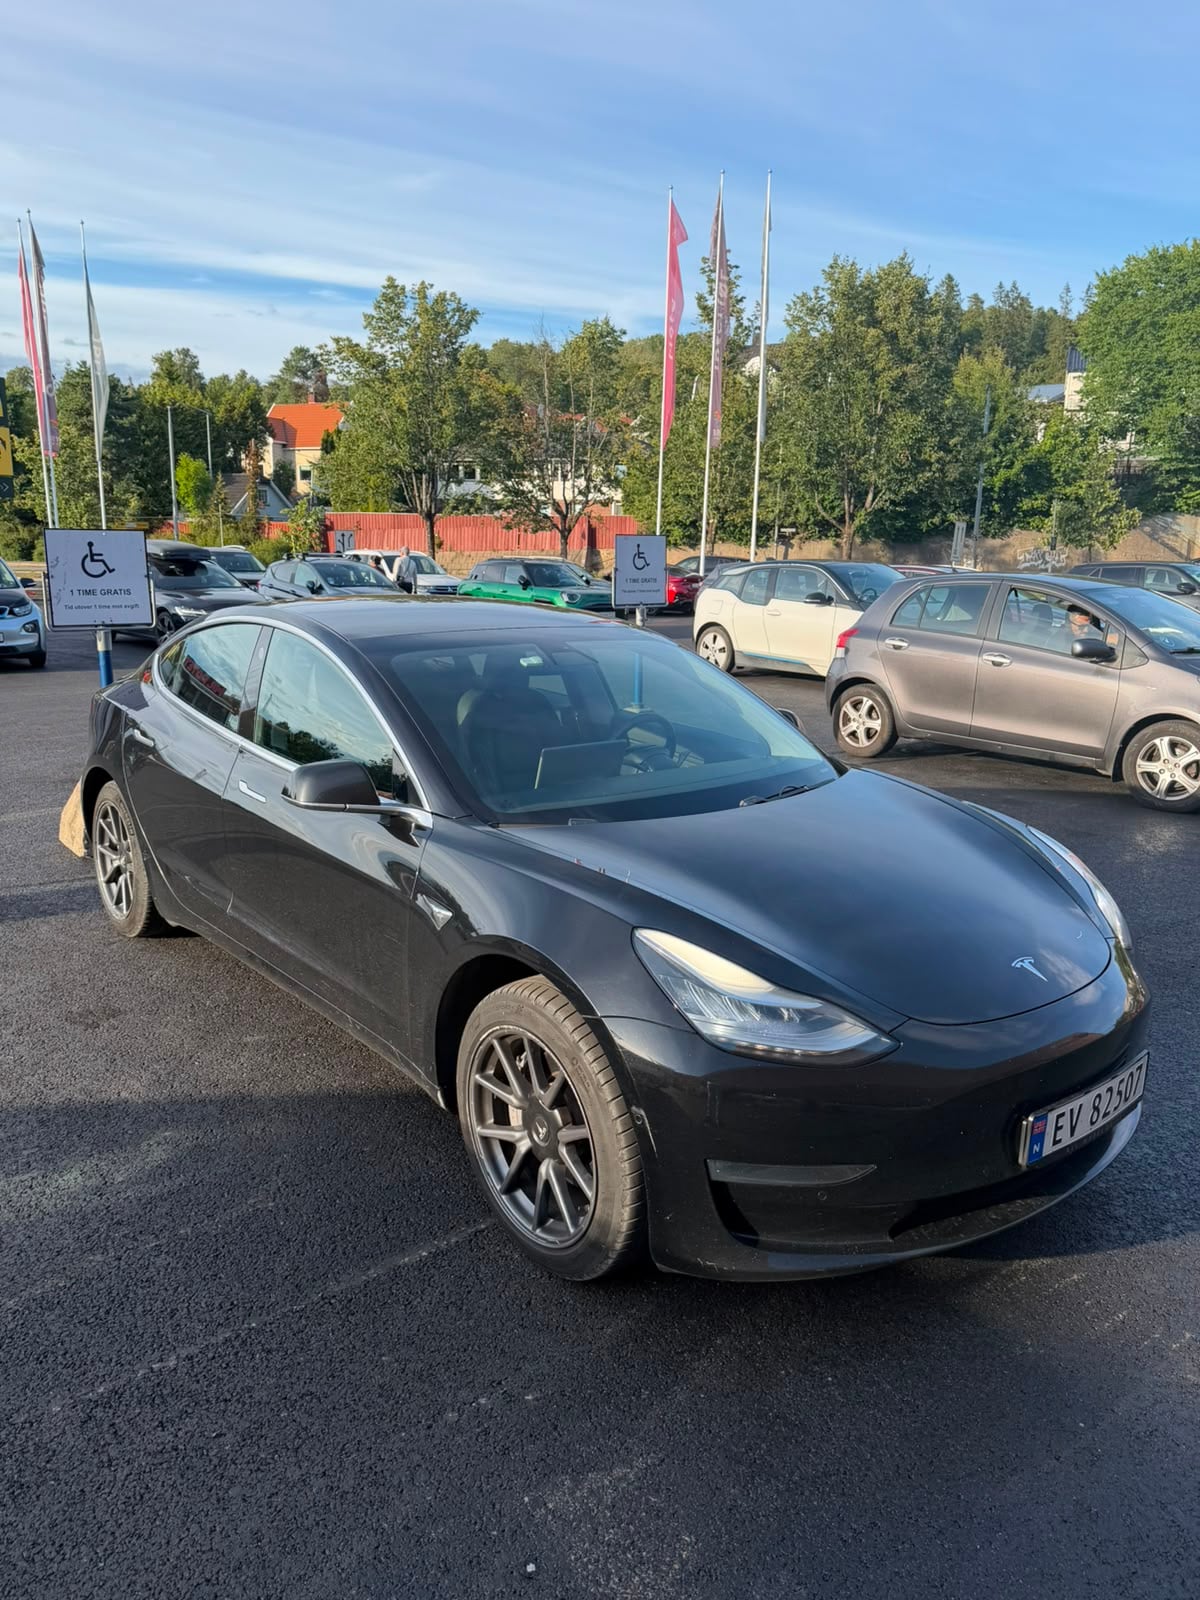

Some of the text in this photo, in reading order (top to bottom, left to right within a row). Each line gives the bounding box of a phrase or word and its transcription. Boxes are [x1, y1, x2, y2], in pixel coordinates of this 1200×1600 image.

[100, 588, 132, 596] GRATIS
[1052, 1103, 1083, 1147] EV
[1090, 1063, 1144, 1127] 82507
[1032, 1142, 1041, 1155] N
